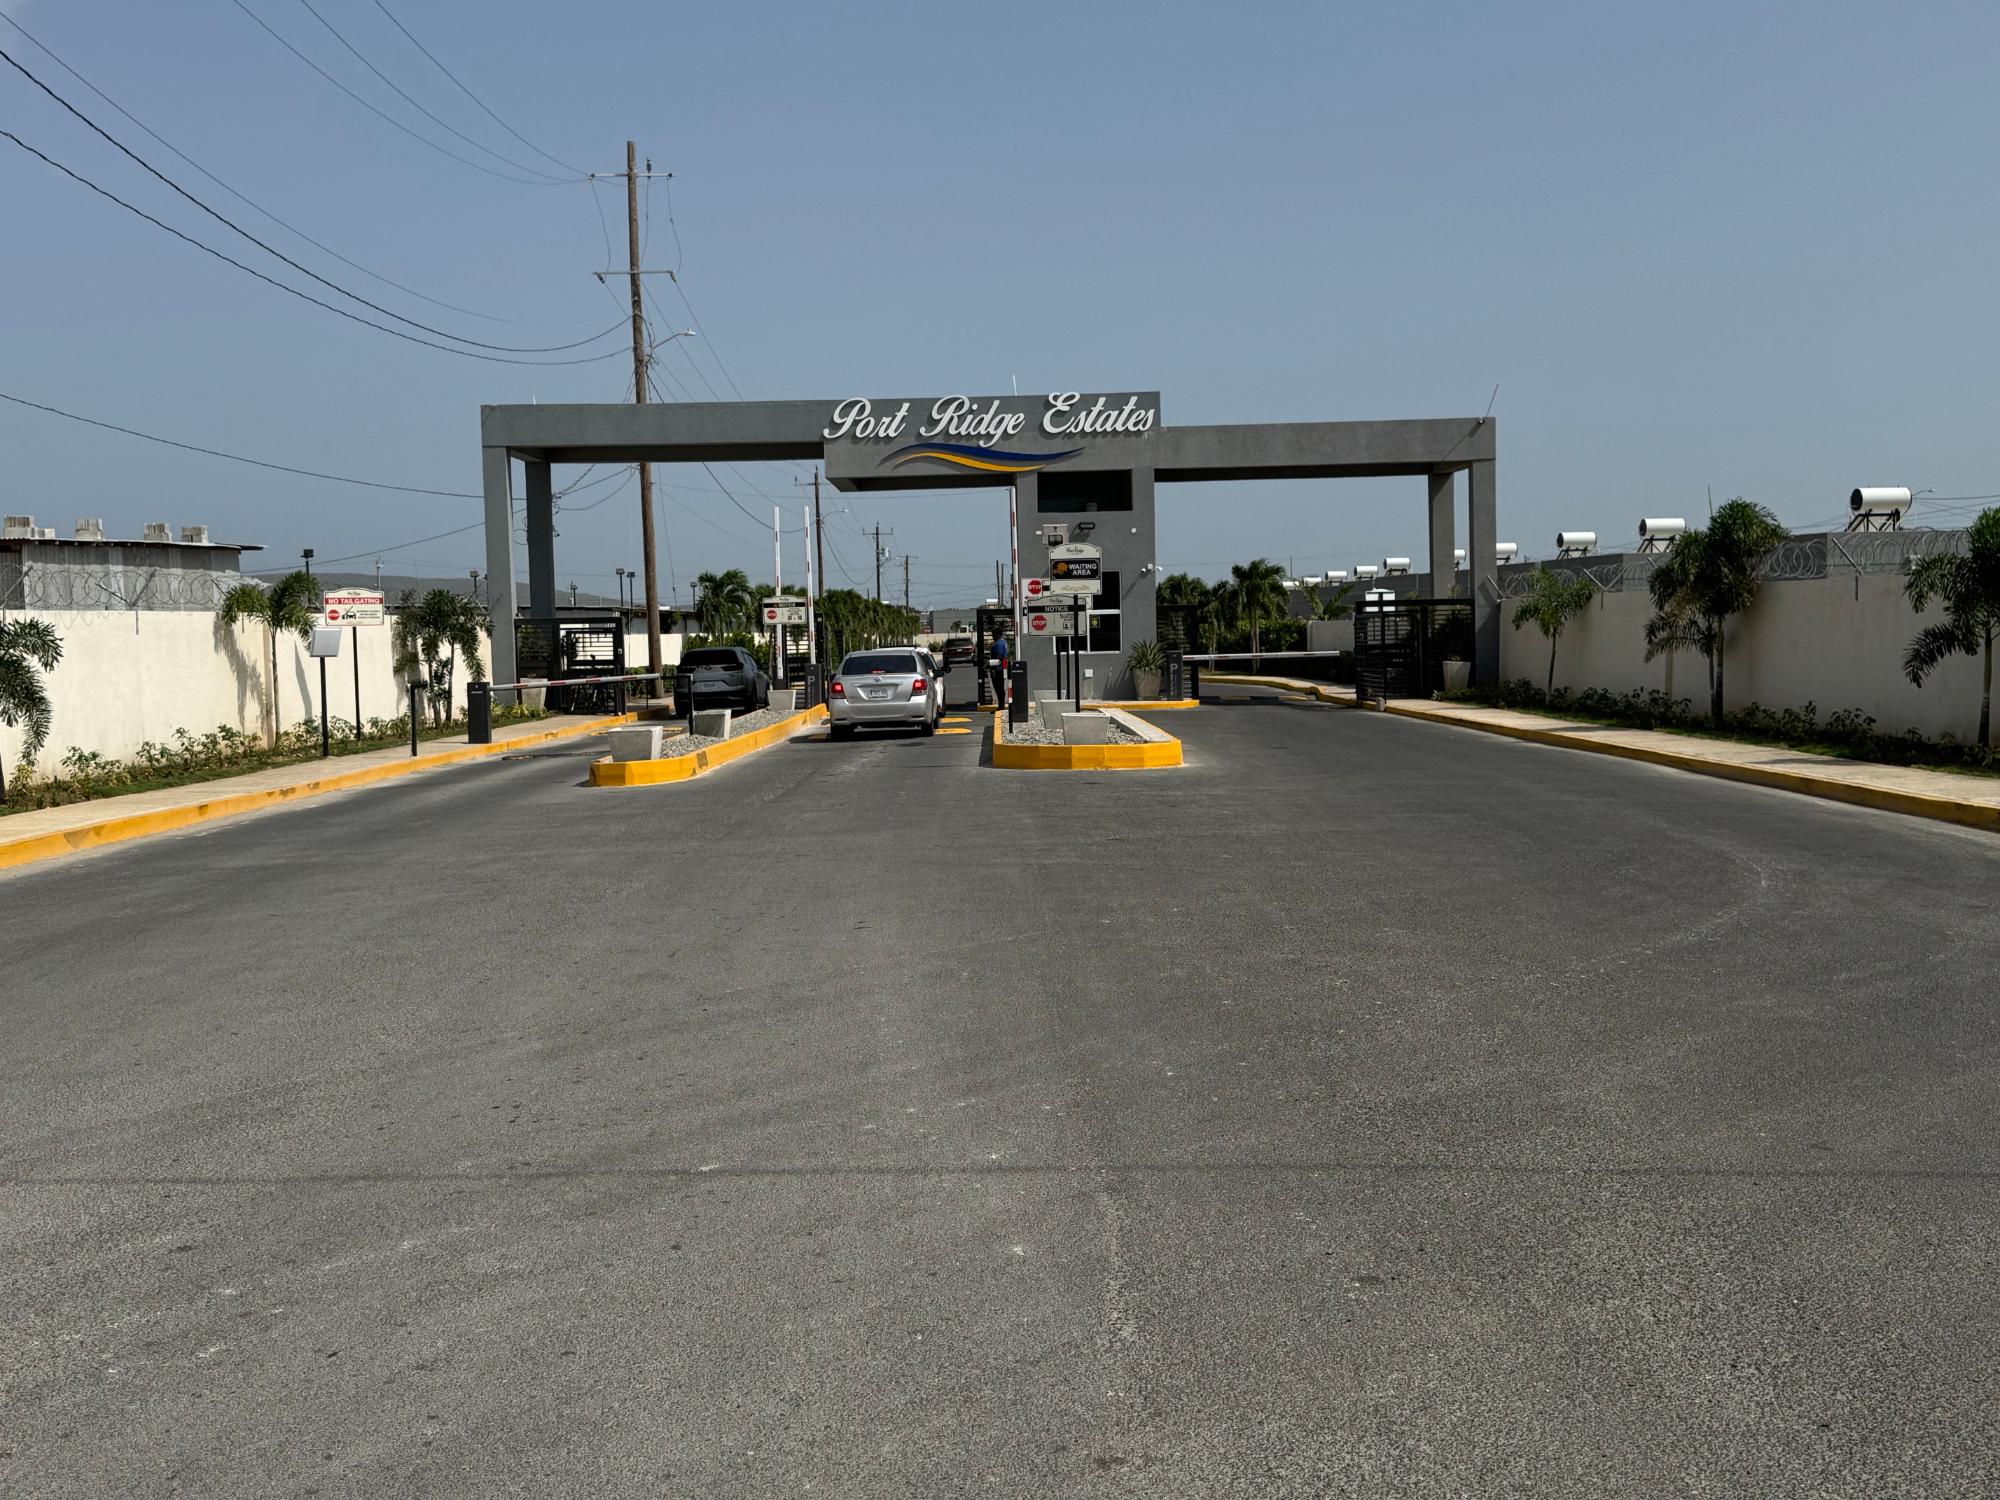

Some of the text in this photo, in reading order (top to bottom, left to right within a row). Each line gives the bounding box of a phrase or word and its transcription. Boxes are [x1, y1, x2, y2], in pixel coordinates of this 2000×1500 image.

[822, 391, 1156, 448] Port Ridge Estates
